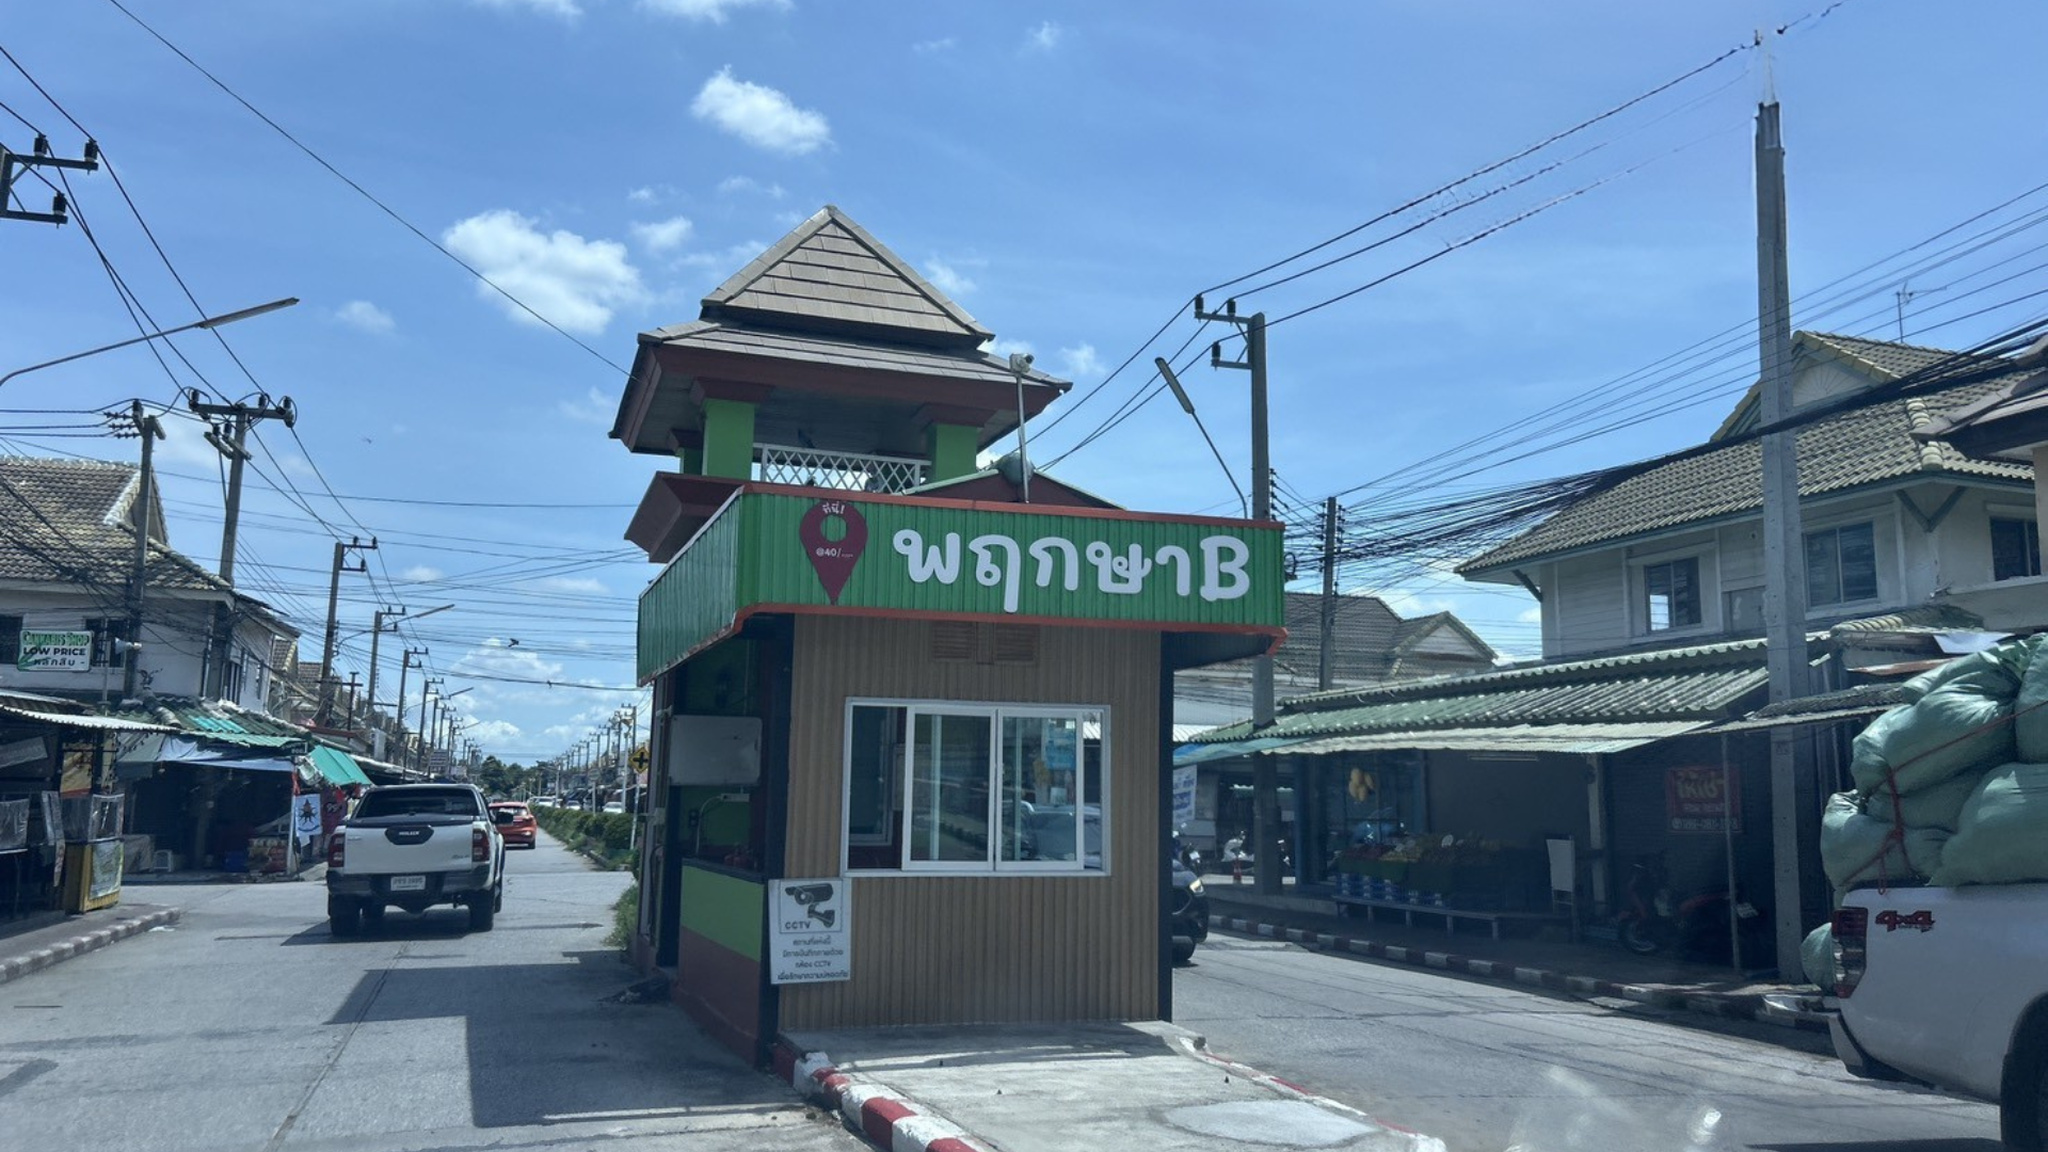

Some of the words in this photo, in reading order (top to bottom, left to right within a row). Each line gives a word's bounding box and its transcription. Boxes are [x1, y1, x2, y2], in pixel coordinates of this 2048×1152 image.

[23, 647, 51, 656] LOW
[53, 647, 87, 656] PRICE
[784, 921, 811, 930] CCTV
